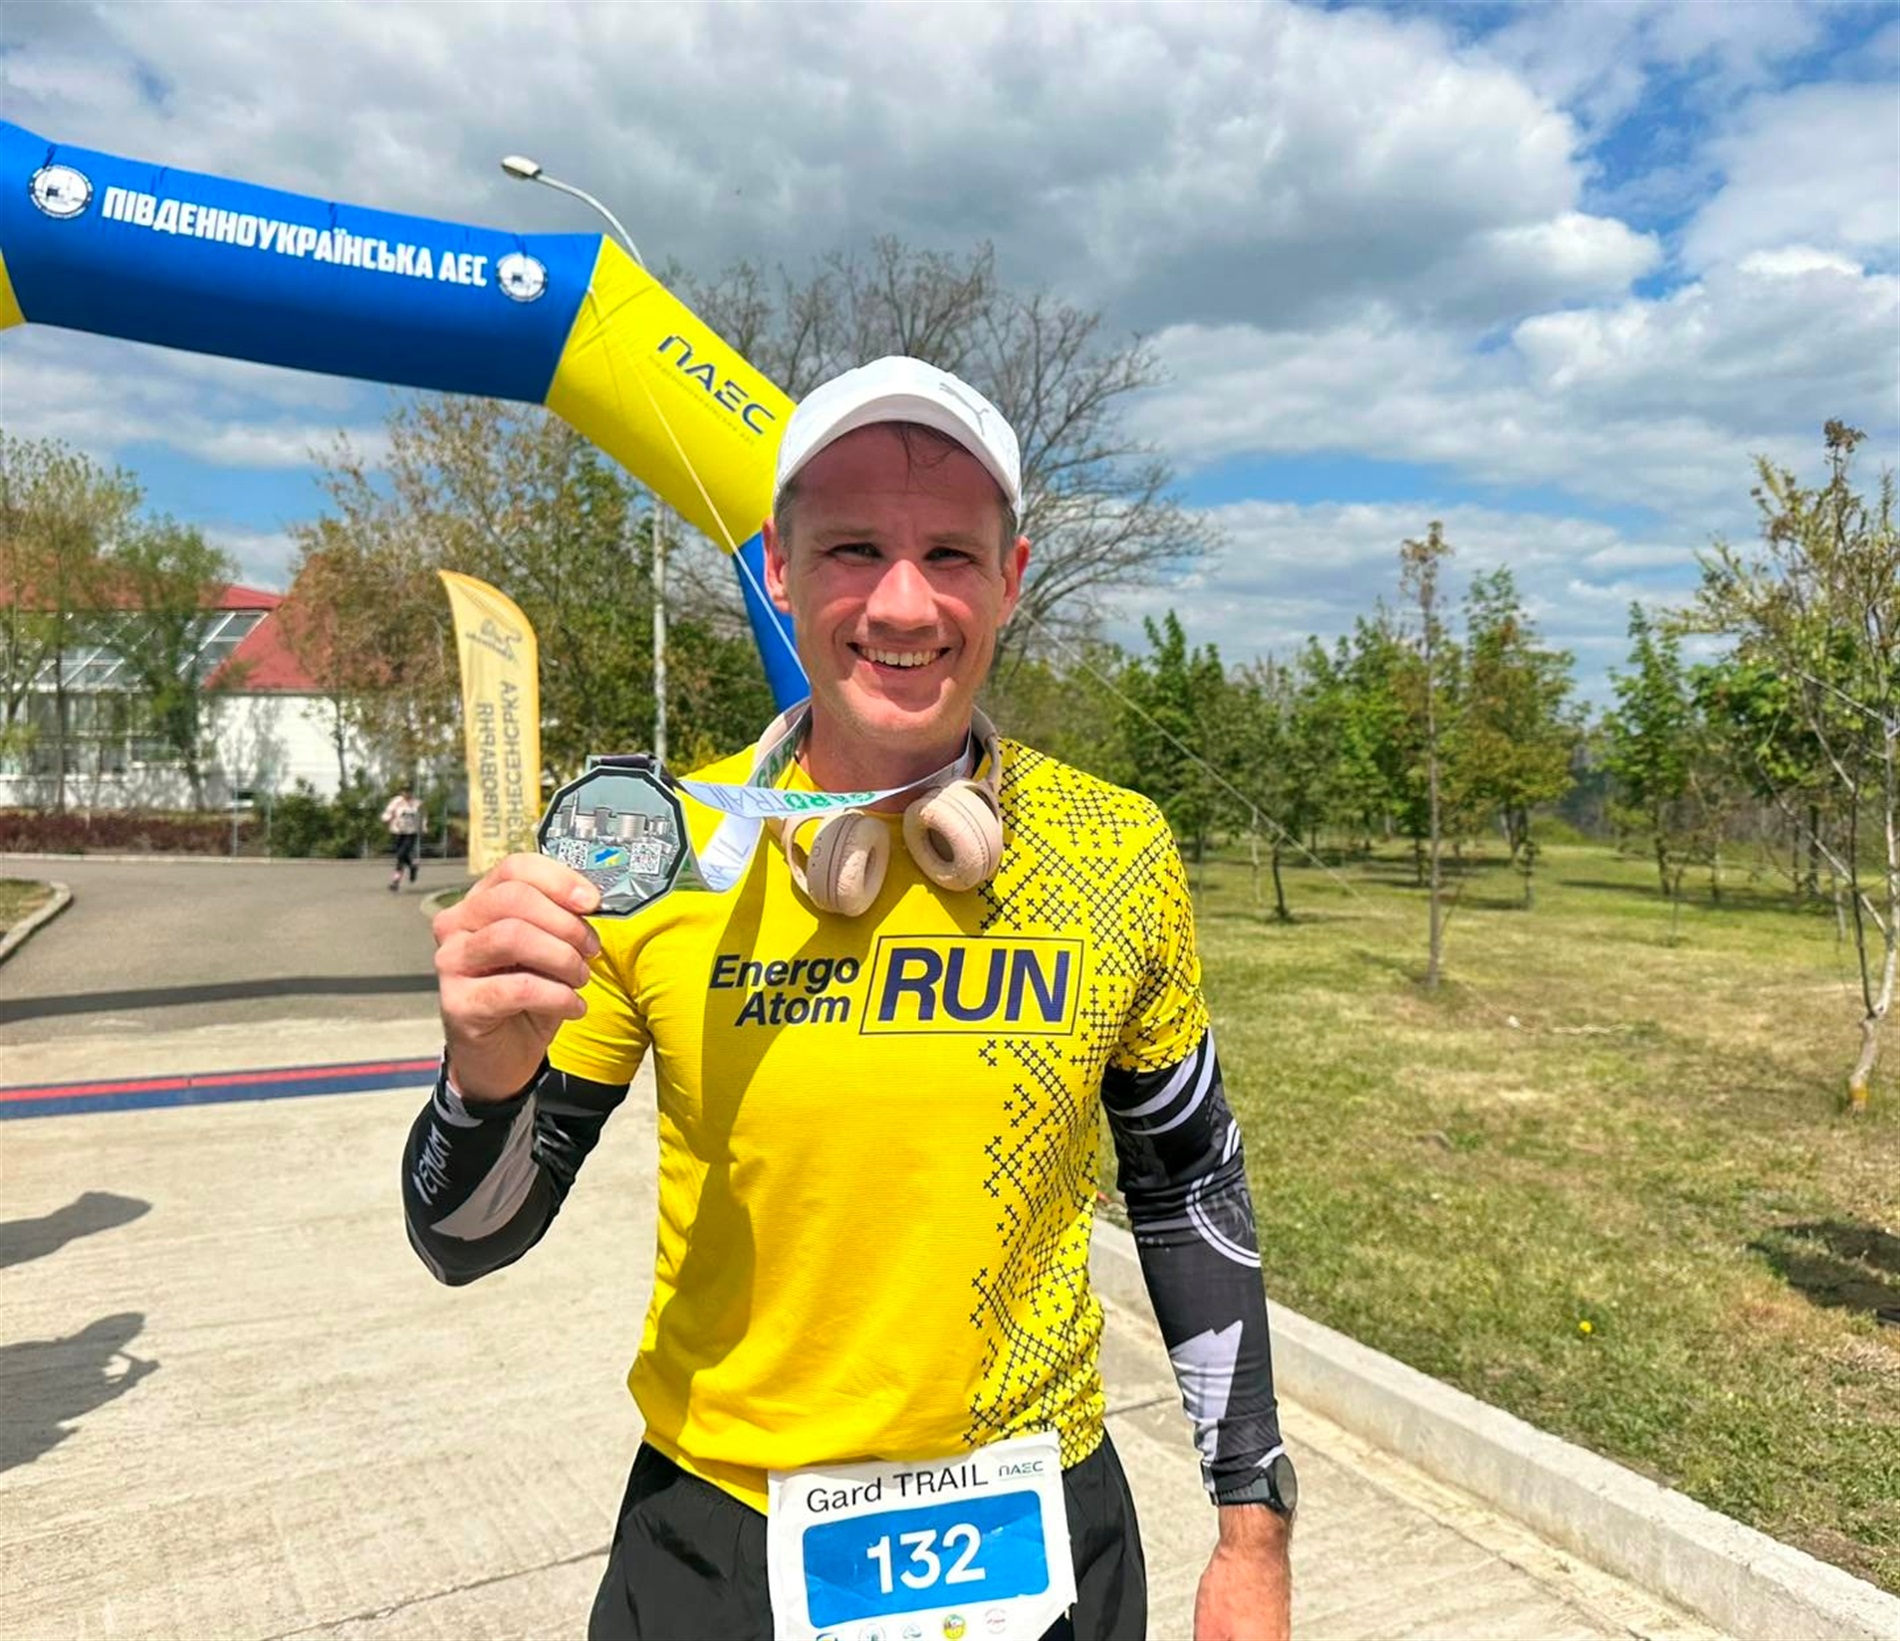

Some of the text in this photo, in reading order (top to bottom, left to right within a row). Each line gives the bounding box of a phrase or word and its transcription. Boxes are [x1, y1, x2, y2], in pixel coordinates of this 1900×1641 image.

[101, 186, 433, 279] ПІВДЕННОУКРАЇНСЬКА
[438, 251, 488, 287] АЕС
[709, 954, 860, 994] Energo
[877, 947, 1071, 1023] RUN
[734, 991, 850, 1027] Atom
[806, 1464, 988, 1513] Gard TRAIL
[867, 1523, 986, 1594] 132
